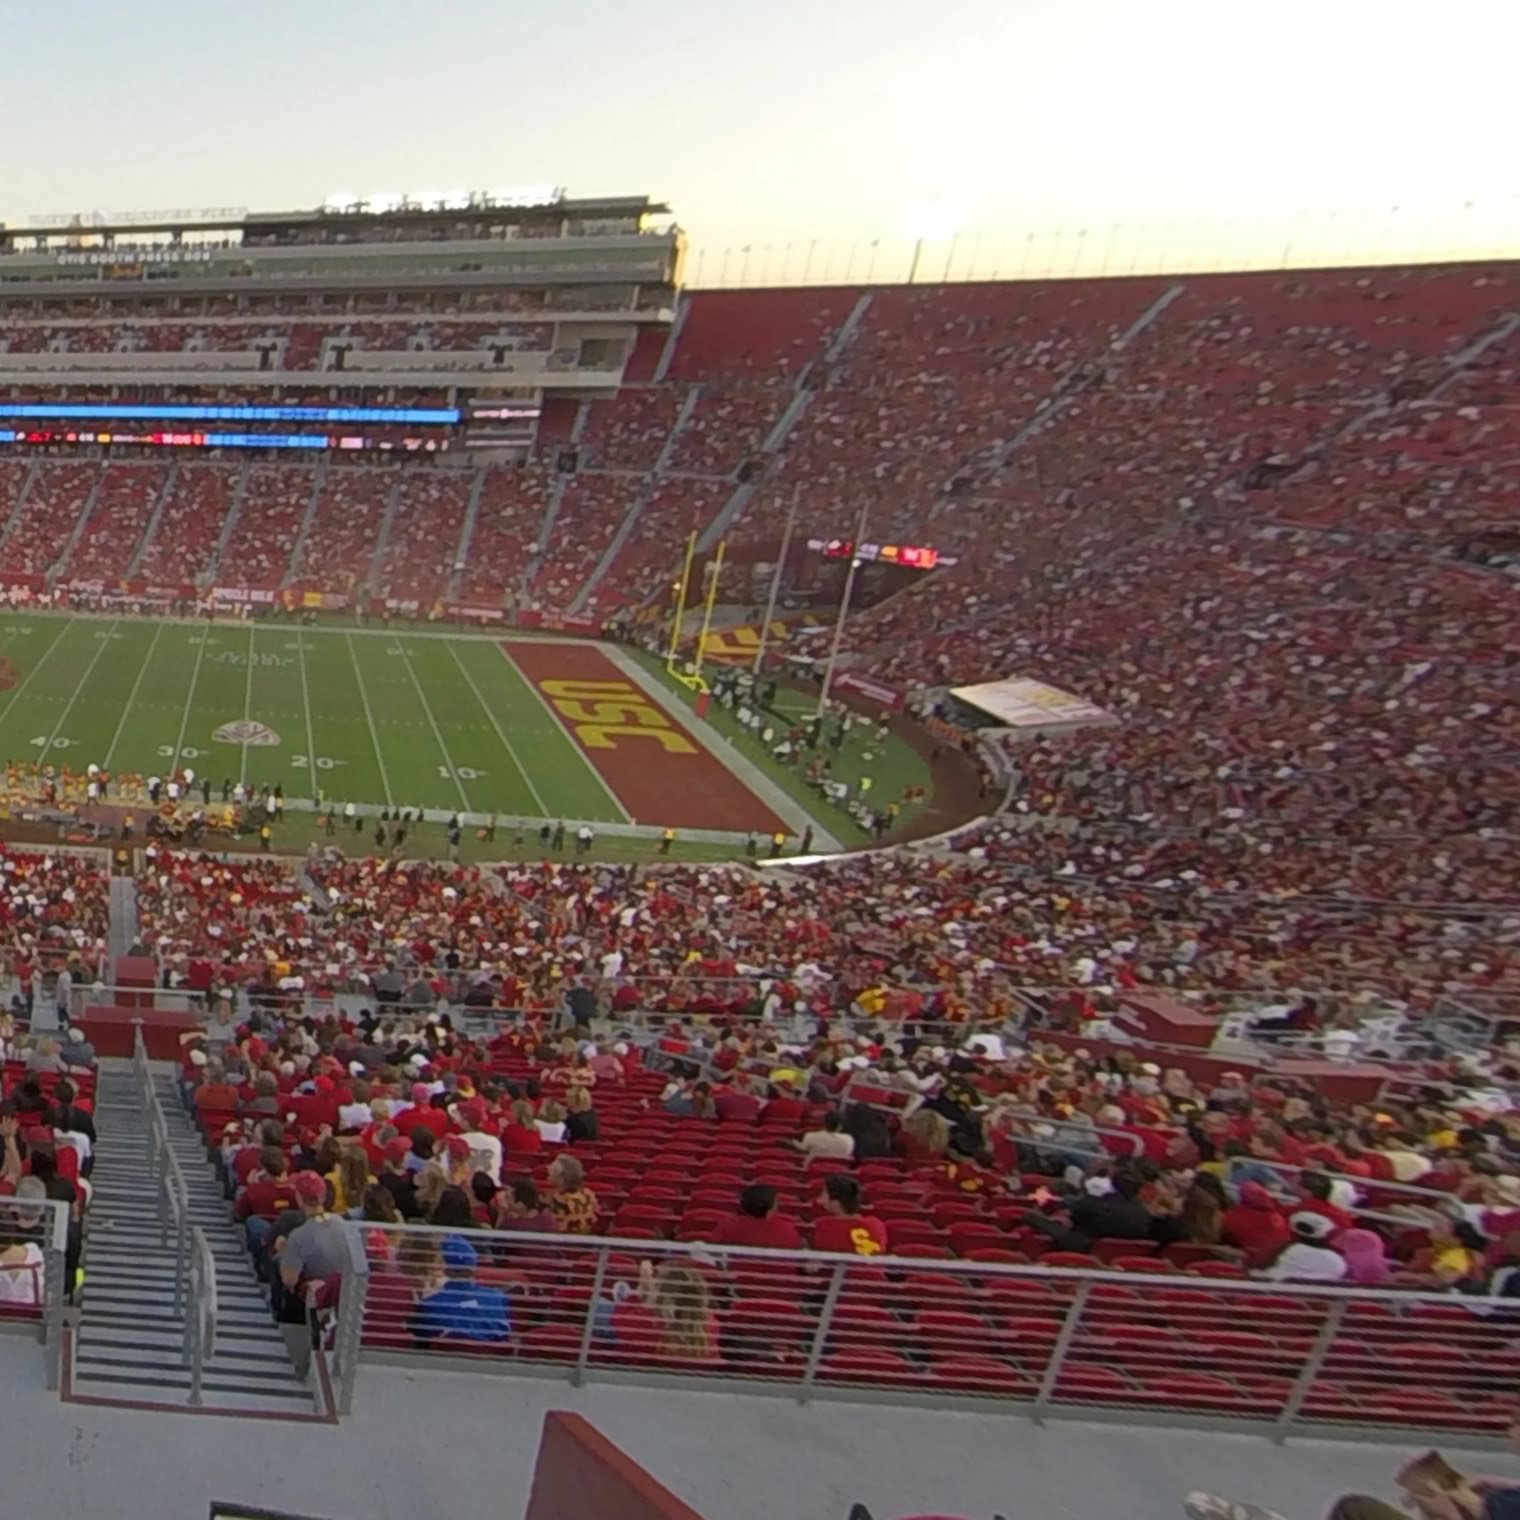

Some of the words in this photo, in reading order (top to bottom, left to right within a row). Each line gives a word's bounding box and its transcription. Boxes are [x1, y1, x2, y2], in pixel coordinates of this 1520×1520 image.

[539, 679, 700, 754] USC
[29, 735, 71, 749] 40
[157, 744, 200, 759] 30
[290, 755, 336, 769] 20
[437, 764, 479, 780] 10
